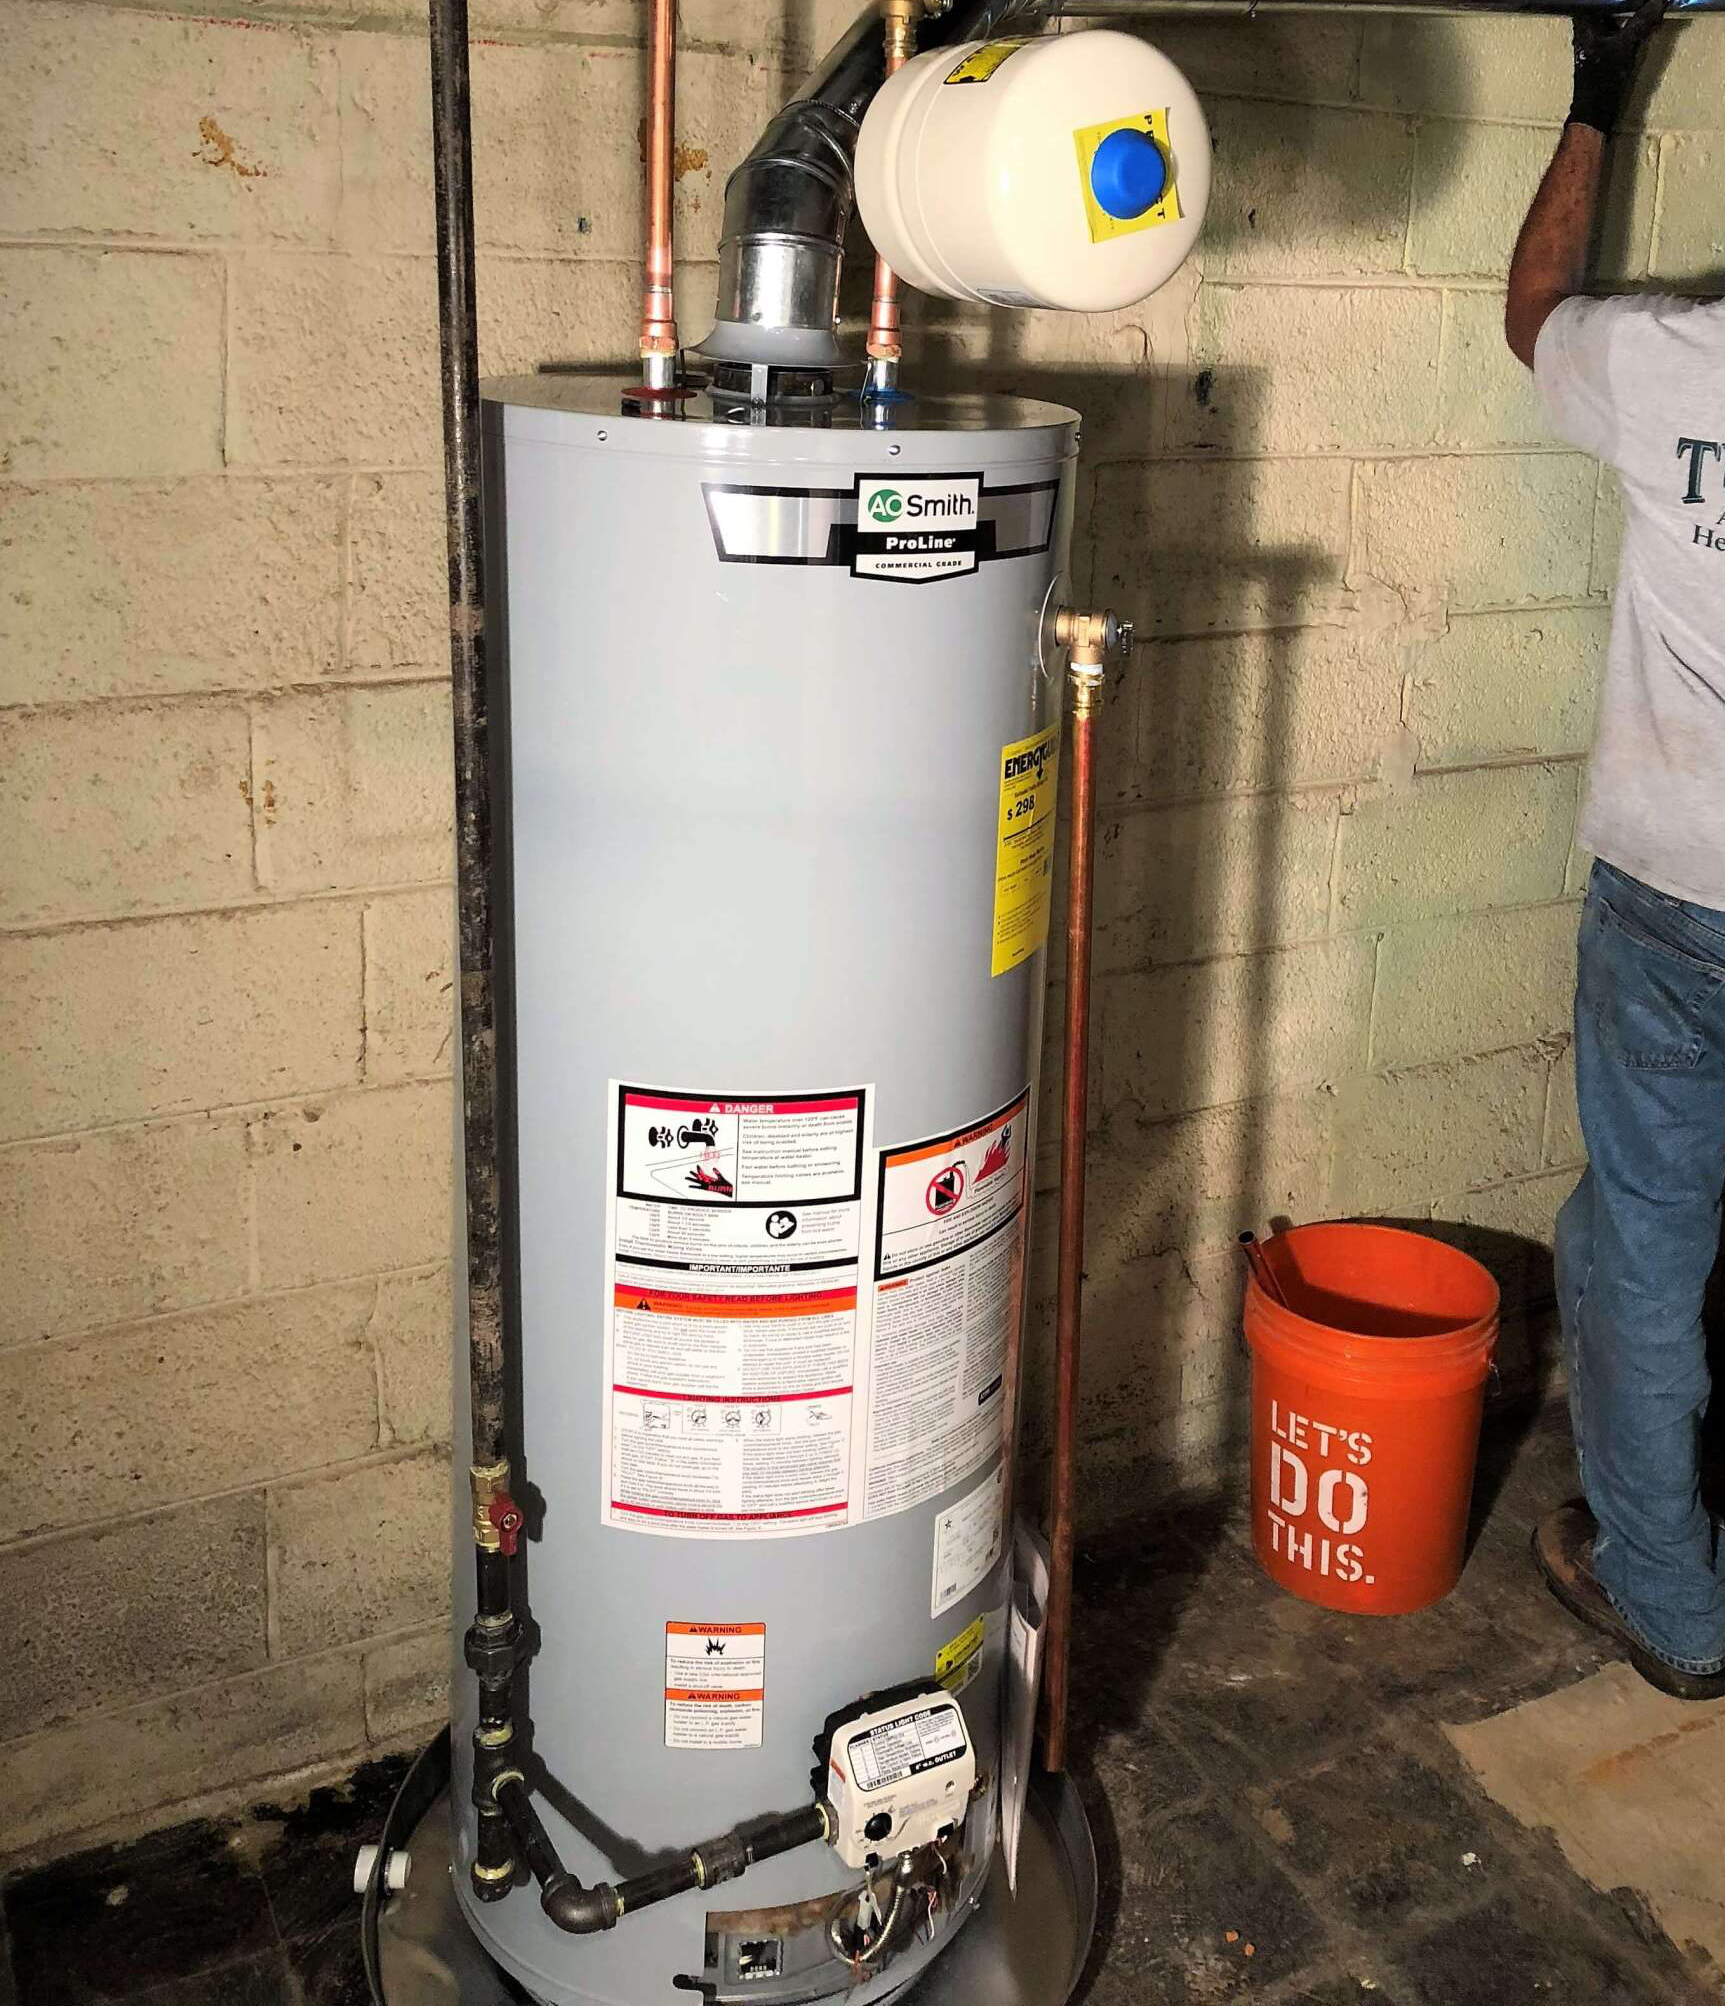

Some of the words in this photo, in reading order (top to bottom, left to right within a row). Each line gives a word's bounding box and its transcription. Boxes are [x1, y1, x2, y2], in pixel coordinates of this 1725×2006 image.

[1676, 437, 1725, 504] T
[867, 489, 904, 523] AO
[875, 561, 933, 569] COMMERCIAL
[935, 560, 962, 568] GRADE
[1015, 794, 1036, 818] 298
[725, 1103, 774, 1114] DANGER
[961, 1124, 993, 1145] WARNING
[688, 1263, 791, 1274] IMPORTANT/IMPORTANTE
[1270, 1440, 1369, 1535] DO
[1267, 1509, 1375, 1584] THIS.
[698, 1626, 742, 1634] WARNING
[870, 1721, 895, 1737] STATUS
[894, 1715, 914, 1728] LIGHT
[914, 1709, 931, 1721] CODE
[934, 1750, 957, 1764] OUTLET
